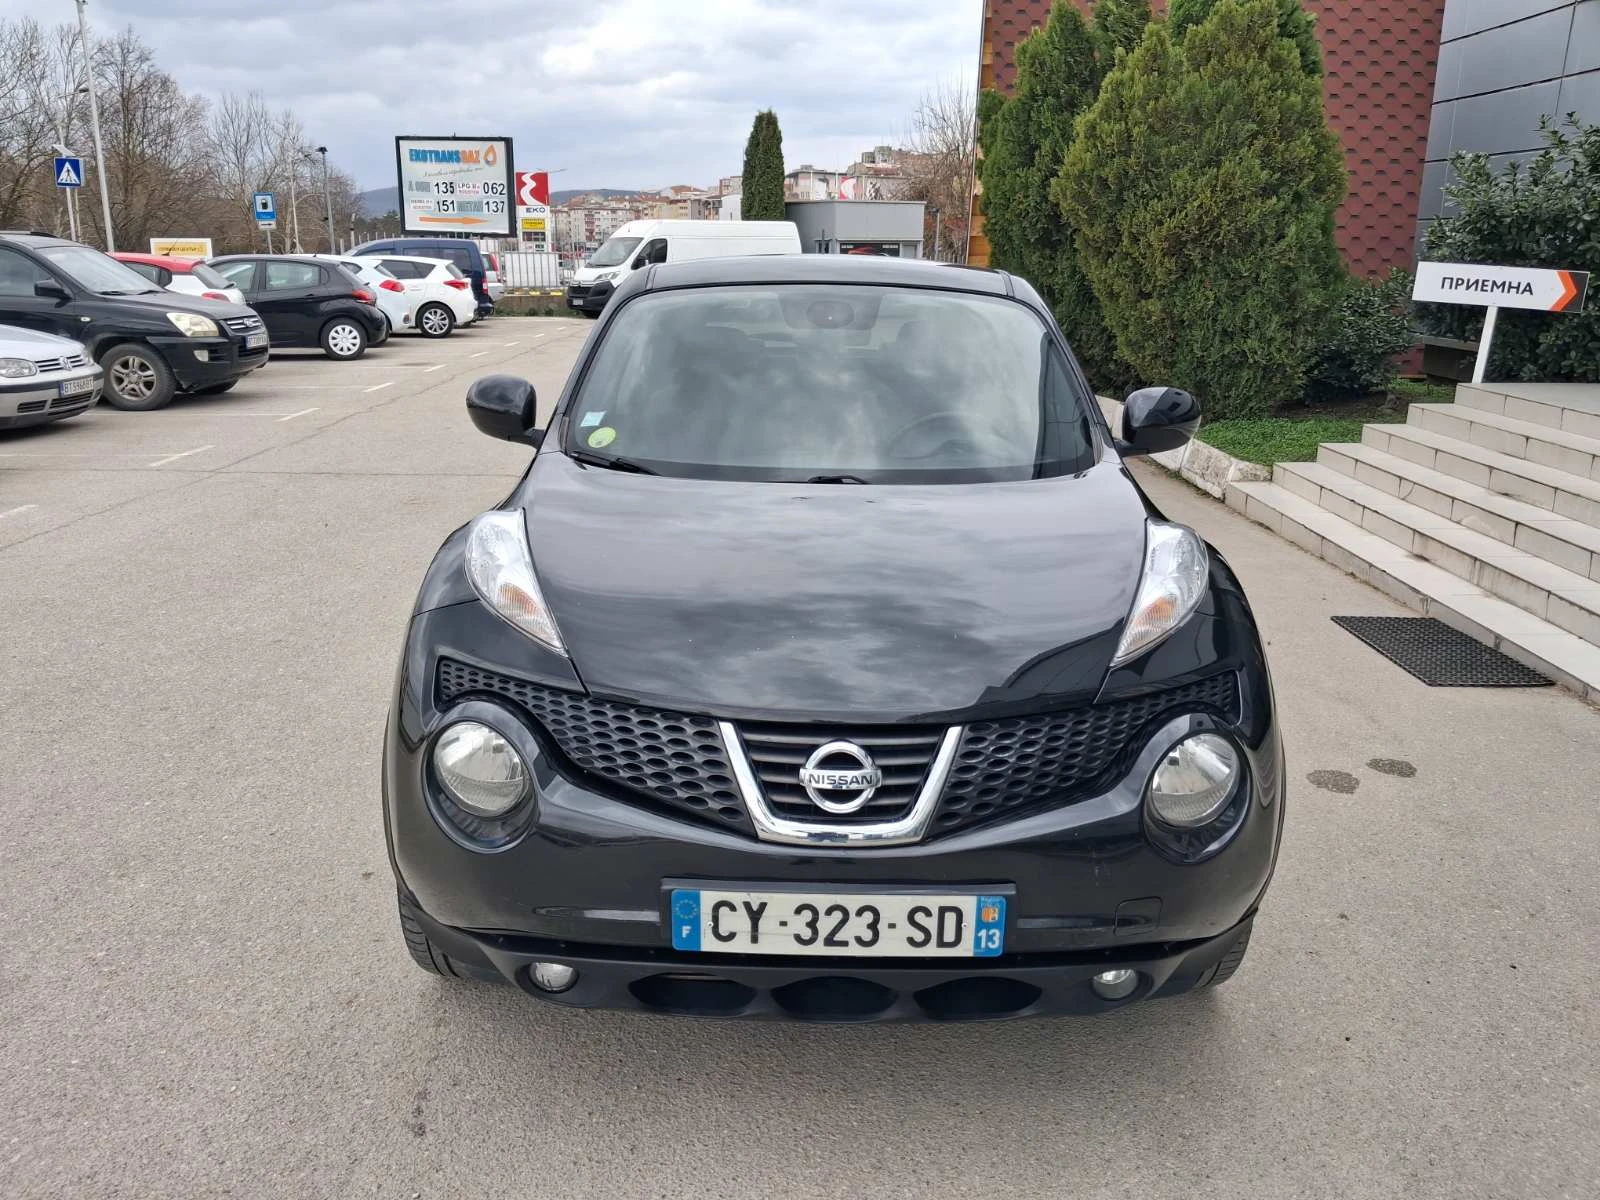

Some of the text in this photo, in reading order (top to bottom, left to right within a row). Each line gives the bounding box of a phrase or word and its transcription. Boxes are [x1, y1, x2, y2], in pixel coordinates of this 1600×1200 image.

[434, 182, 455, 194] 135
[483, 181, 506, 196] 062
[436, 199, 456, 213] 151
[484, 200, 505, 213] 137
[1440, 276, 1534, 296] ПРИЕМНА
[809, 773, 873, 786] NISSAN
[681, 926, 691, 939] F
[711, 900, 964, 949] CY-323-SD
[977, 928, 1001, 949] 13
